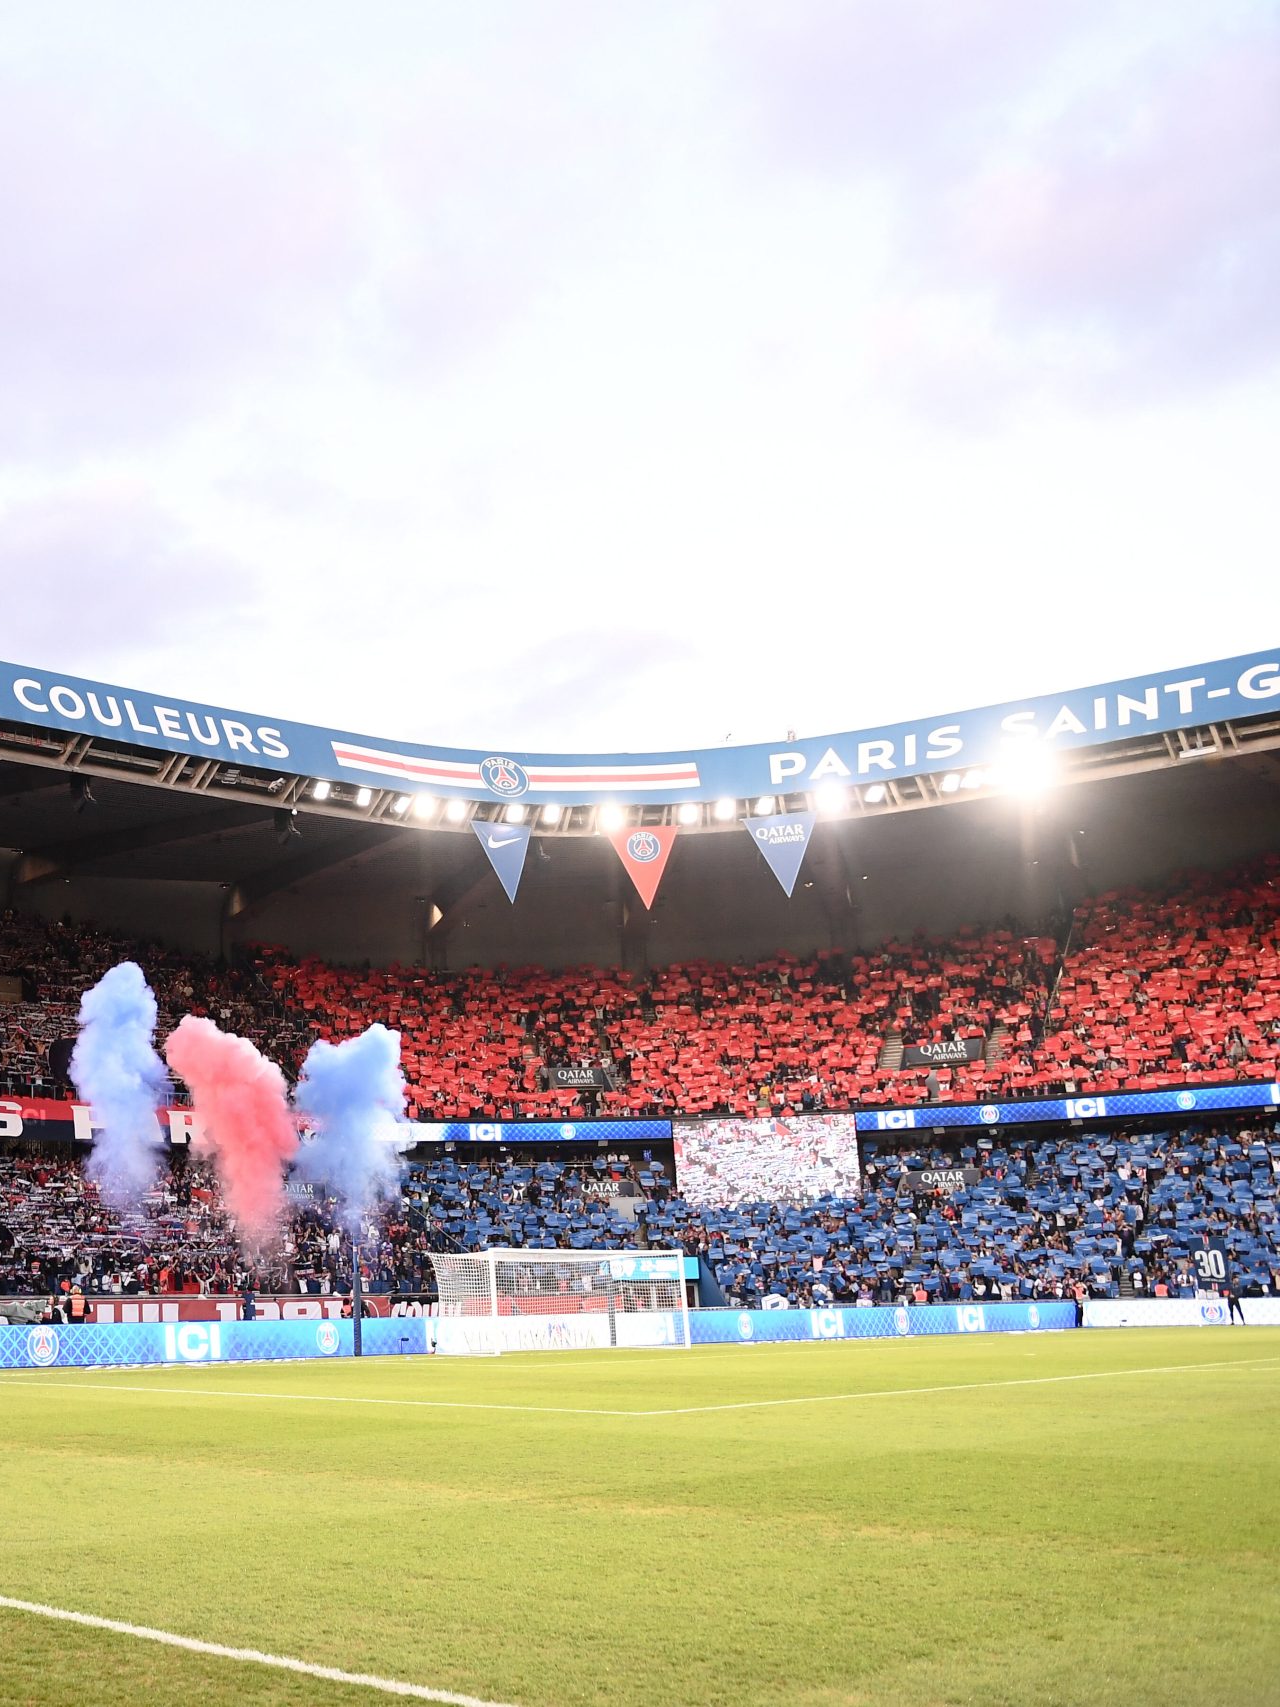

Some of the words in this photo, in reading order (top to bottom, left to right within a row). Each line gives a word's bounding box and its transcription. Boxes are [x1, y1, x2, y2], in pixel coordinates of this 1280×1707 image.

[12, 677, 290, 759] COULEURS
[769, 724, 964, 785] PARIS
[485, 758, 516, 770] PARIS
[756, 823, 804, 841] QATAR
[768, 832, 806, 844] AIRWAYS
[920, 1041, 966, 1056] QATAR
[932, 1051, 968, 1061] AIRWAYS
[557, 1069, 594, 1081] QATAR
[1065, 1097, 1106, 1119] ICI
[876, 1109, 915, 1130] ICI
[470, 1124, 502, 1141] ICI
[921, 1171, 964, 1184] QATAR
[581, 1182, 620, 1194] QATAR
[1194, 1250, 1226, 1278] 30
[810, 1310, 845, 1338] ICI
[956, 1306, 986, 1332] ICI
[164, 1323, 221, 1360] ICI
